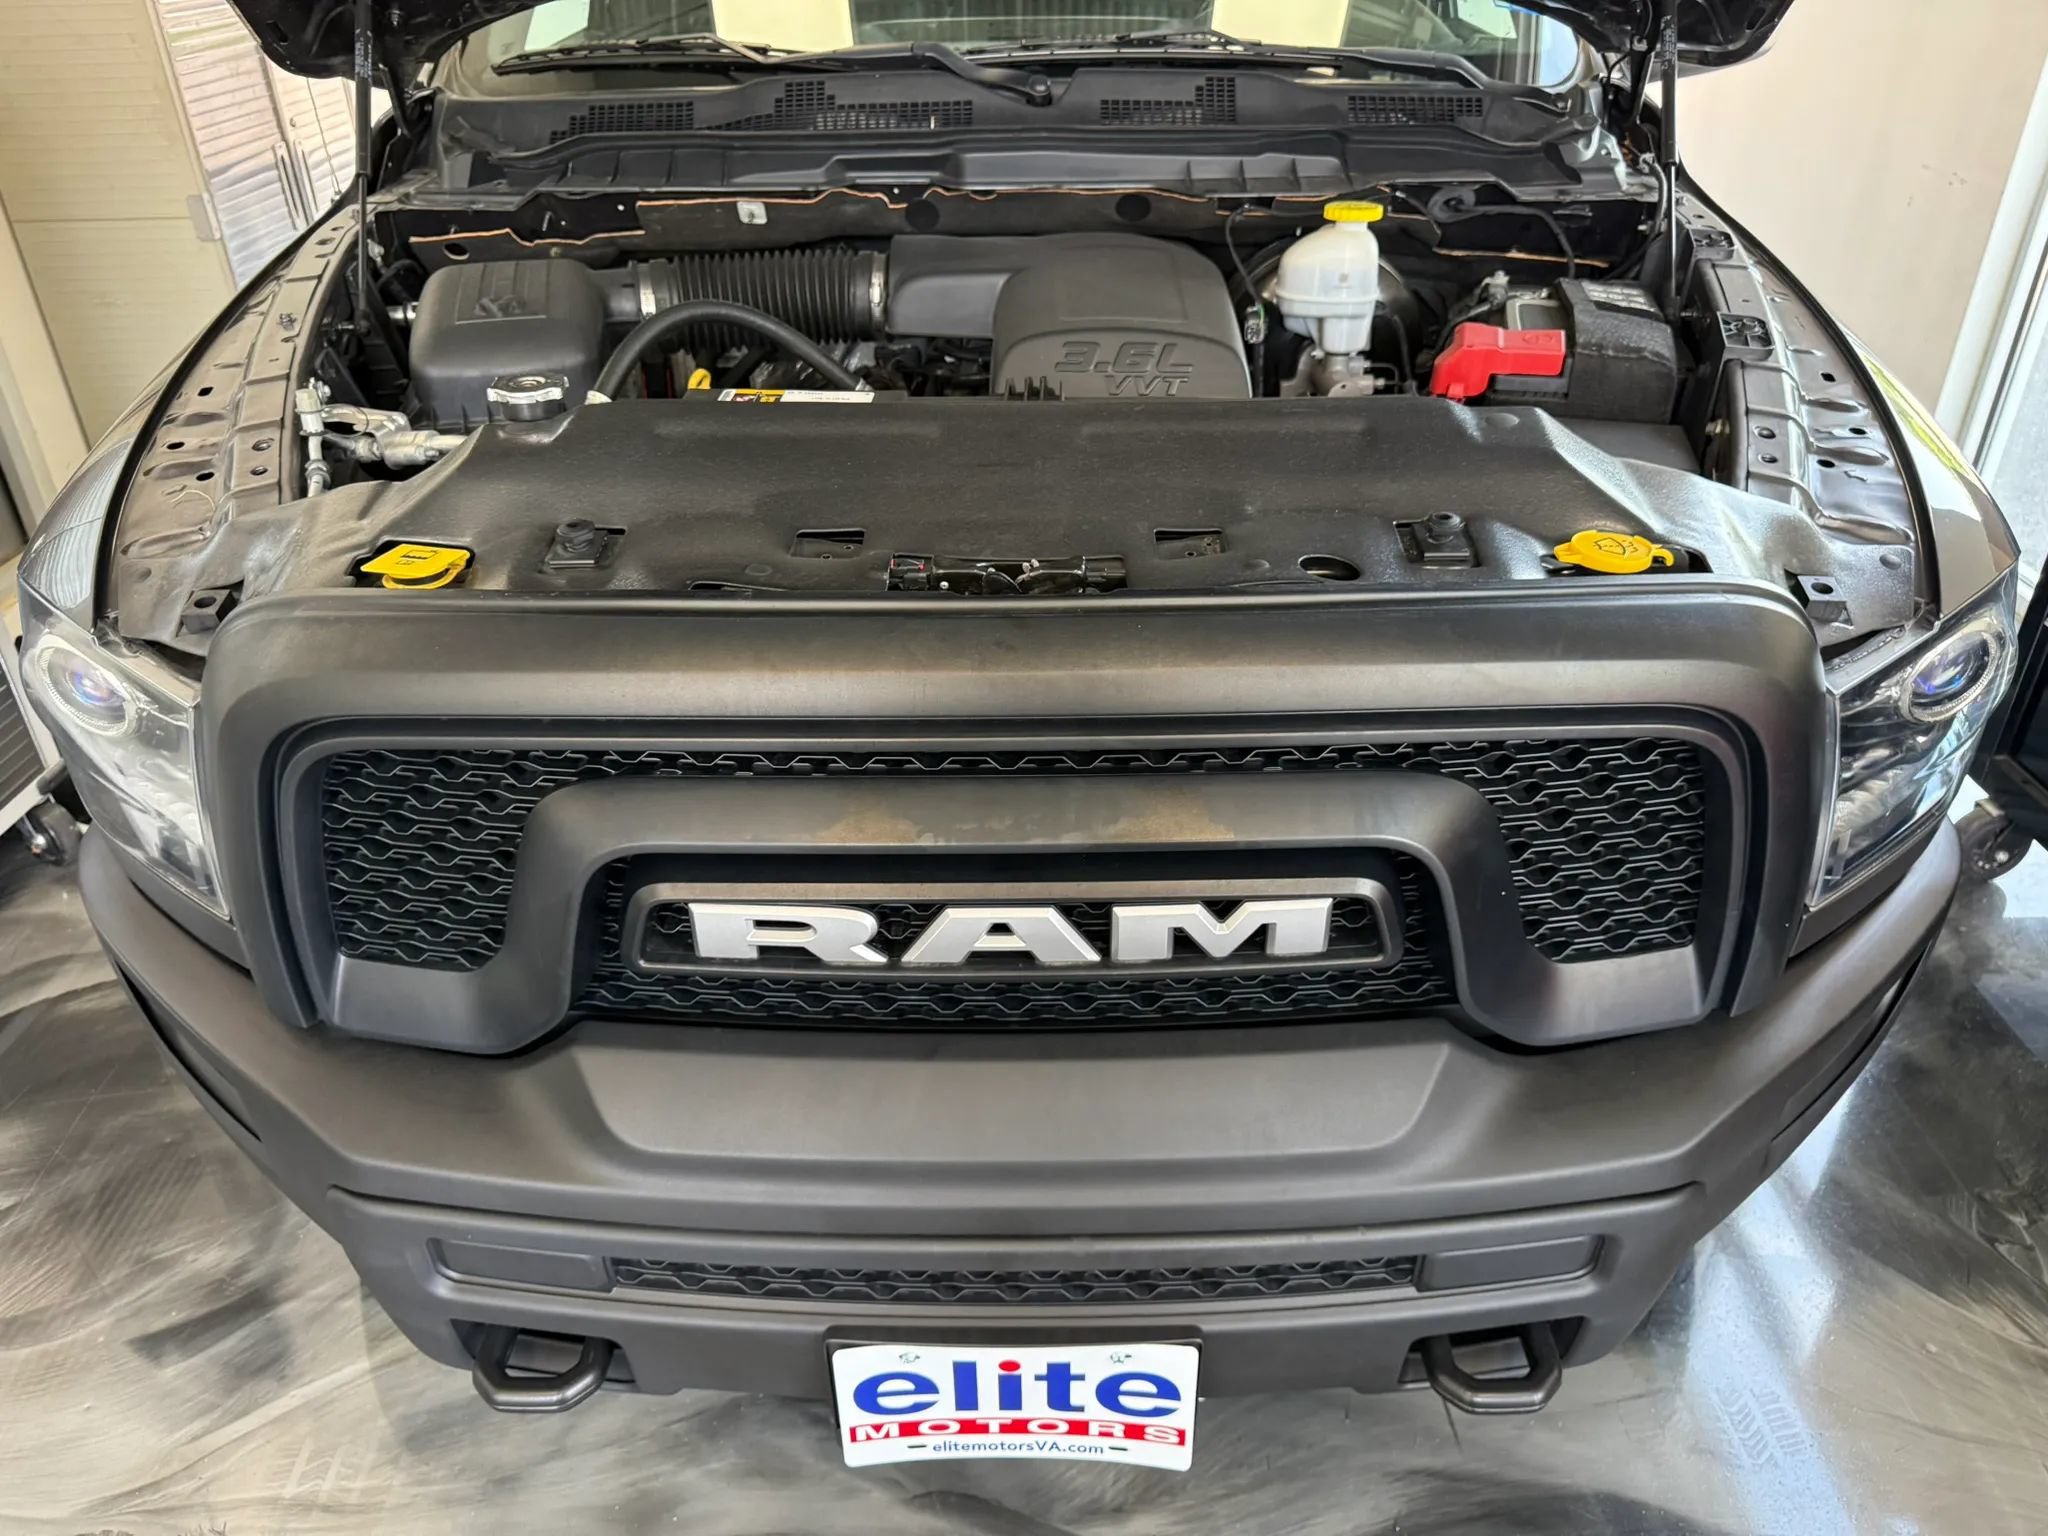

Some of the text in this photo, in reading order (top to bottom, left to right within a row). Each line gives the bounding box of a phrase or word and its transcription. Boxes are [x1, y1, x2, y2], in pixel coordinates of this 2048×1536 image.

[1054, 341, 1194, 373] 3.6L
[1104, 375, 1189, 396] VVT
[688, 898, 1334, 963] RAM
[853, 1360, 1181, 1417] elite
[855, 1418, 1181, 1444] MOTORS
[932, 1440, 1104, 1454] elitemotorsVA.com
